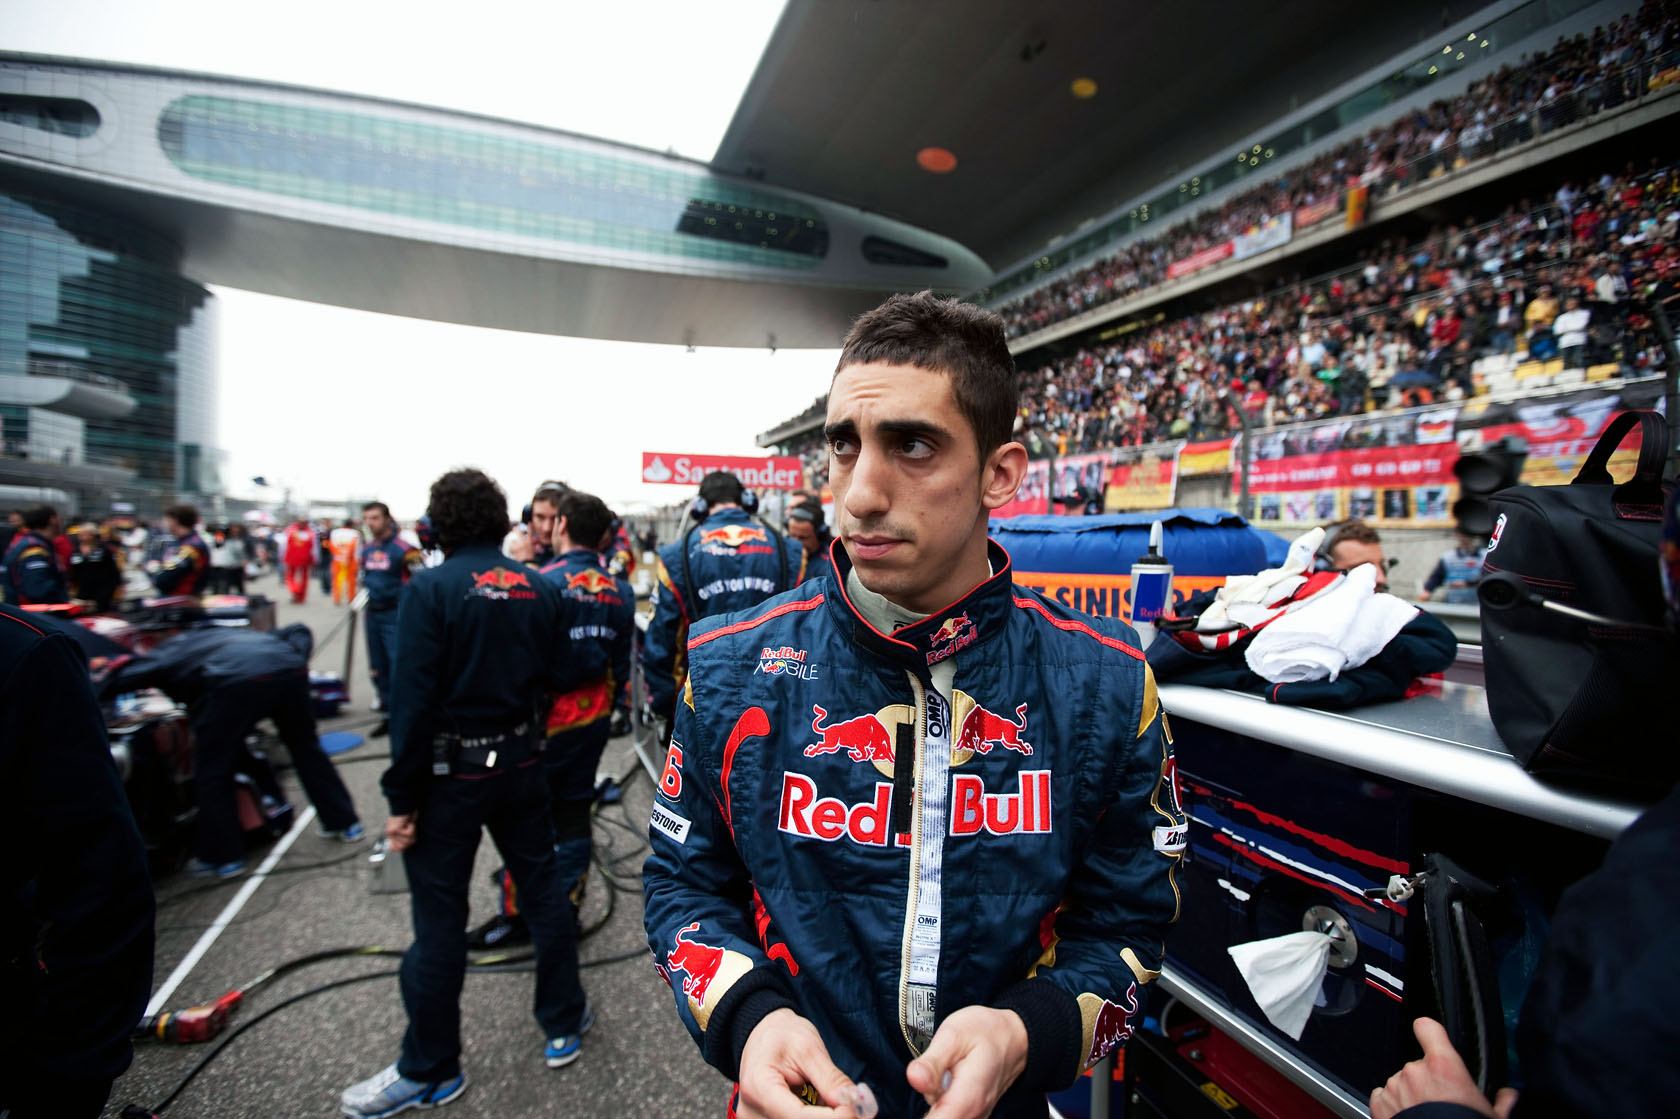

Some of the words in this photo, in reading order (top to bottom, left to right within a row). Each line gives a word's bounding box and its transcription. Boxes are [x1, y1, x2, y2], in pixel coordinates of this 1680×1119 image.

[674, 457, 799, 485] Saander
[753, 660, 818, 680] MOBILE
[927, 694, 943, 738] OMP
[651, 809, 683, 835] ESTONE
[778, 771, 894, 847] Red
[950, 770, 1051, 836] Bull
[917, 916, 938, 926] OMP
